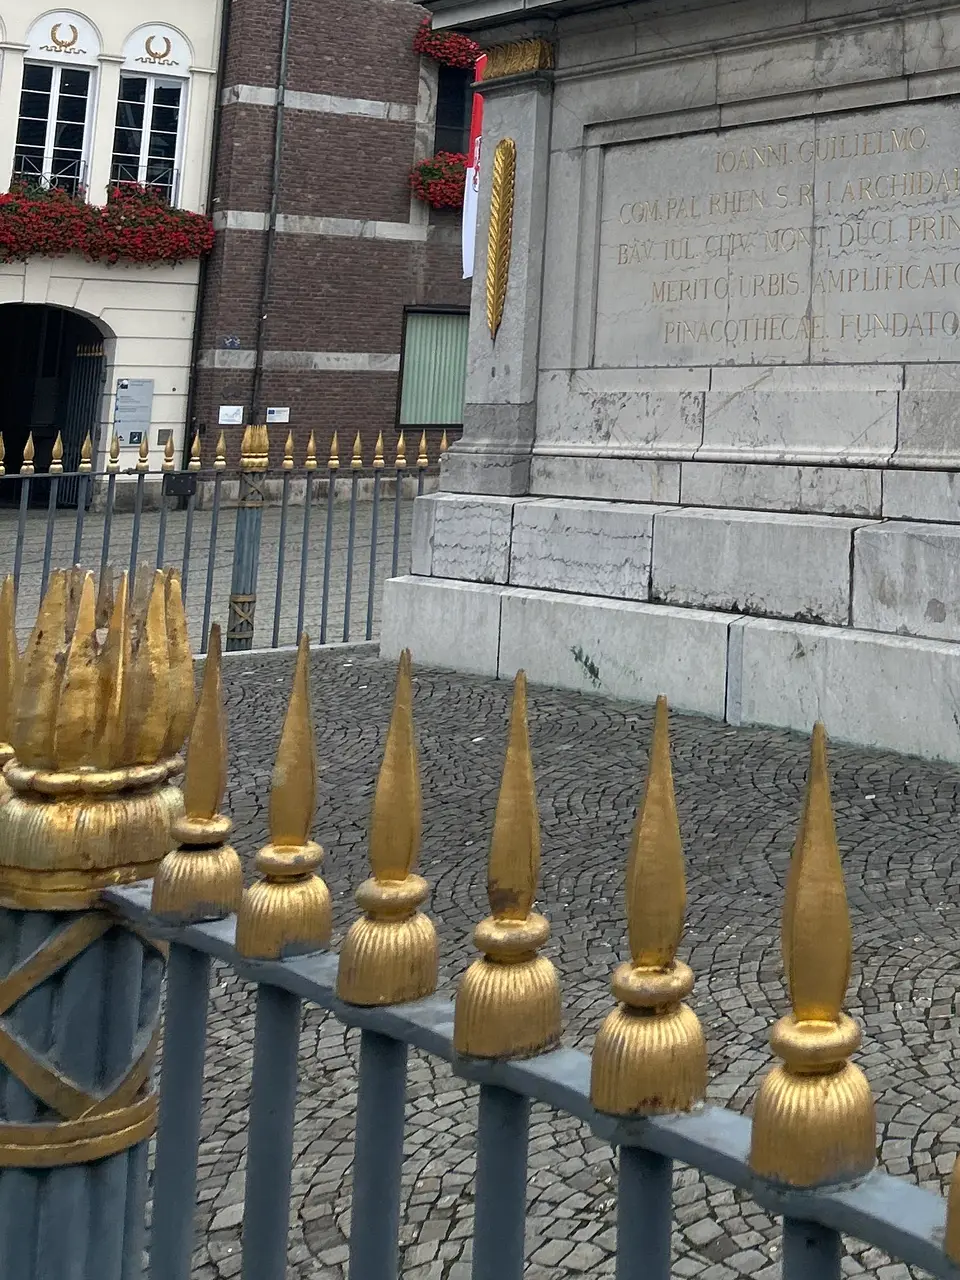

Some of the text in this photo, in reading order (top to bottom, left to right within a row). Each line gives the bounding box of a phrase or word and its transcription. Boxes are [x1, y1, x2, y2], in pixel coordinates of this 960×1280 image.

[716, 125, 930, 173] IOANNI. GUILIELMO.
[664, 315, 829, 344] PINACOTHECAE.
